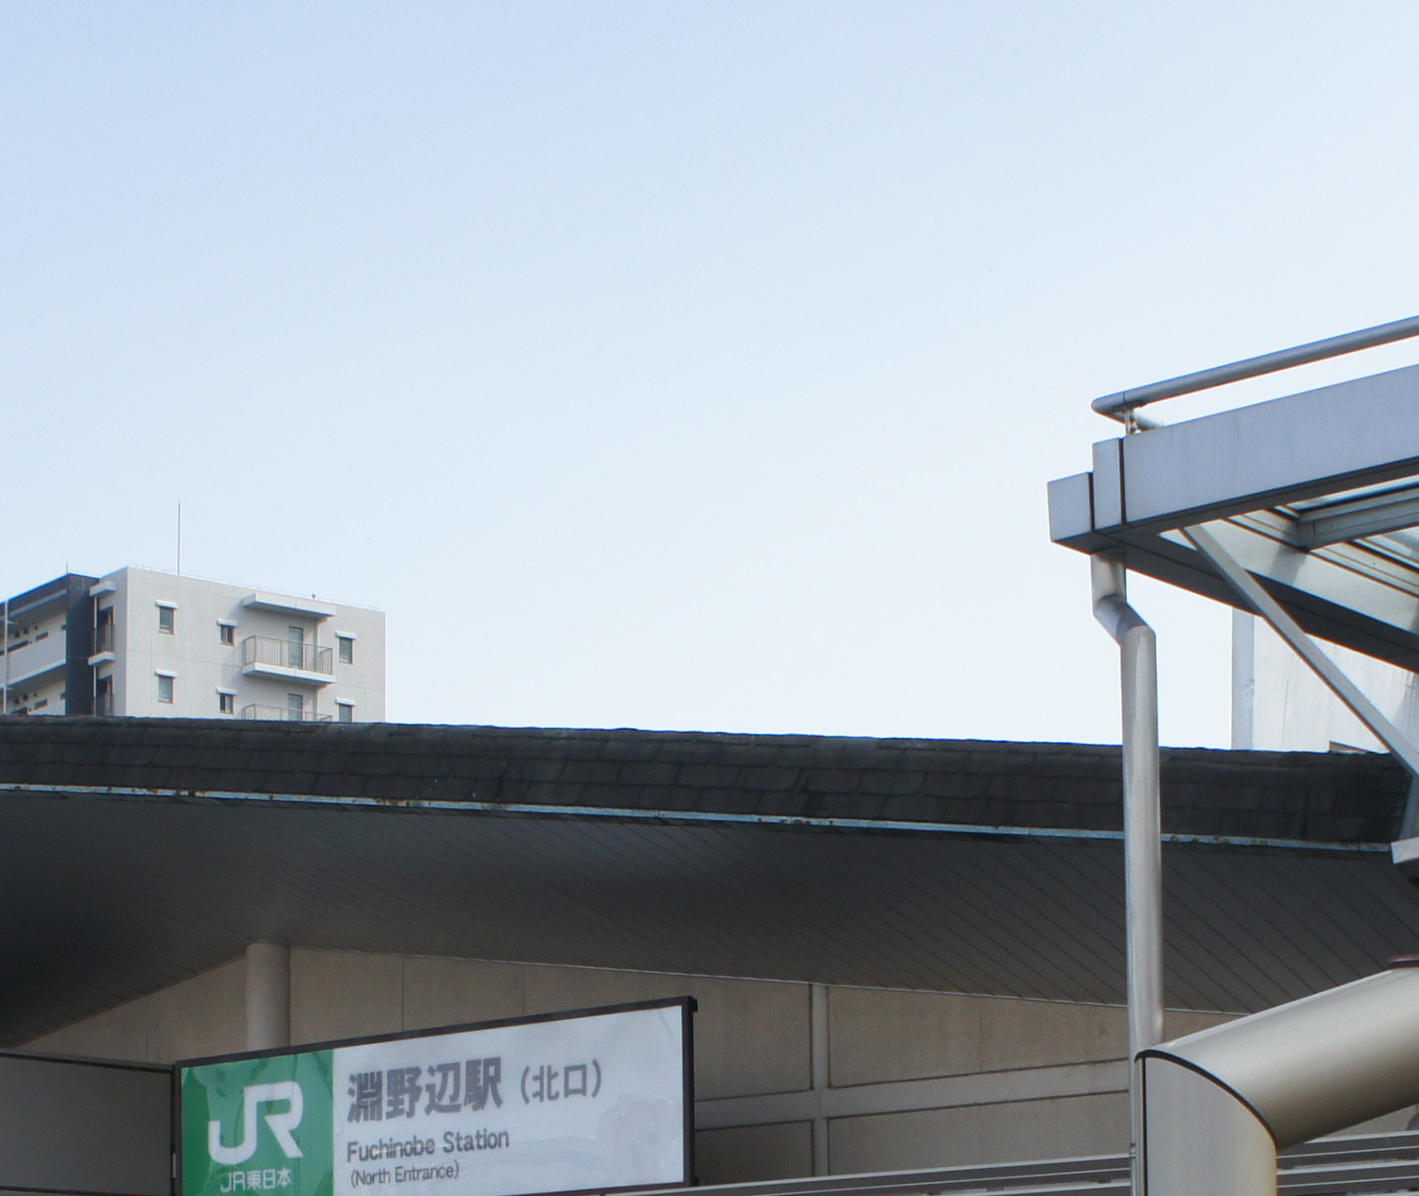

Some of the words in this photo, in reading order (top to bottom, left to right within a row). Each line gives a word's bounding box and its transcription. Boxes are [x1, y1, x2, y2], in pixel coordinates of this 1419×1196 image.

[346, 1056, 504, 1125] 淵野辺駅
[519, 1059, 604, 1106] （北口）
[208, 1081, 304, 1165] JR
[347, 1134, 436, 1163] Fuchinobe
[442, 1128, 510, 1156] Station
[220, 1168, 293, 1194] JR東日本
[350, 1166, 391, 1189] (North
[394, 1160, 460, 1184] Entrance)
